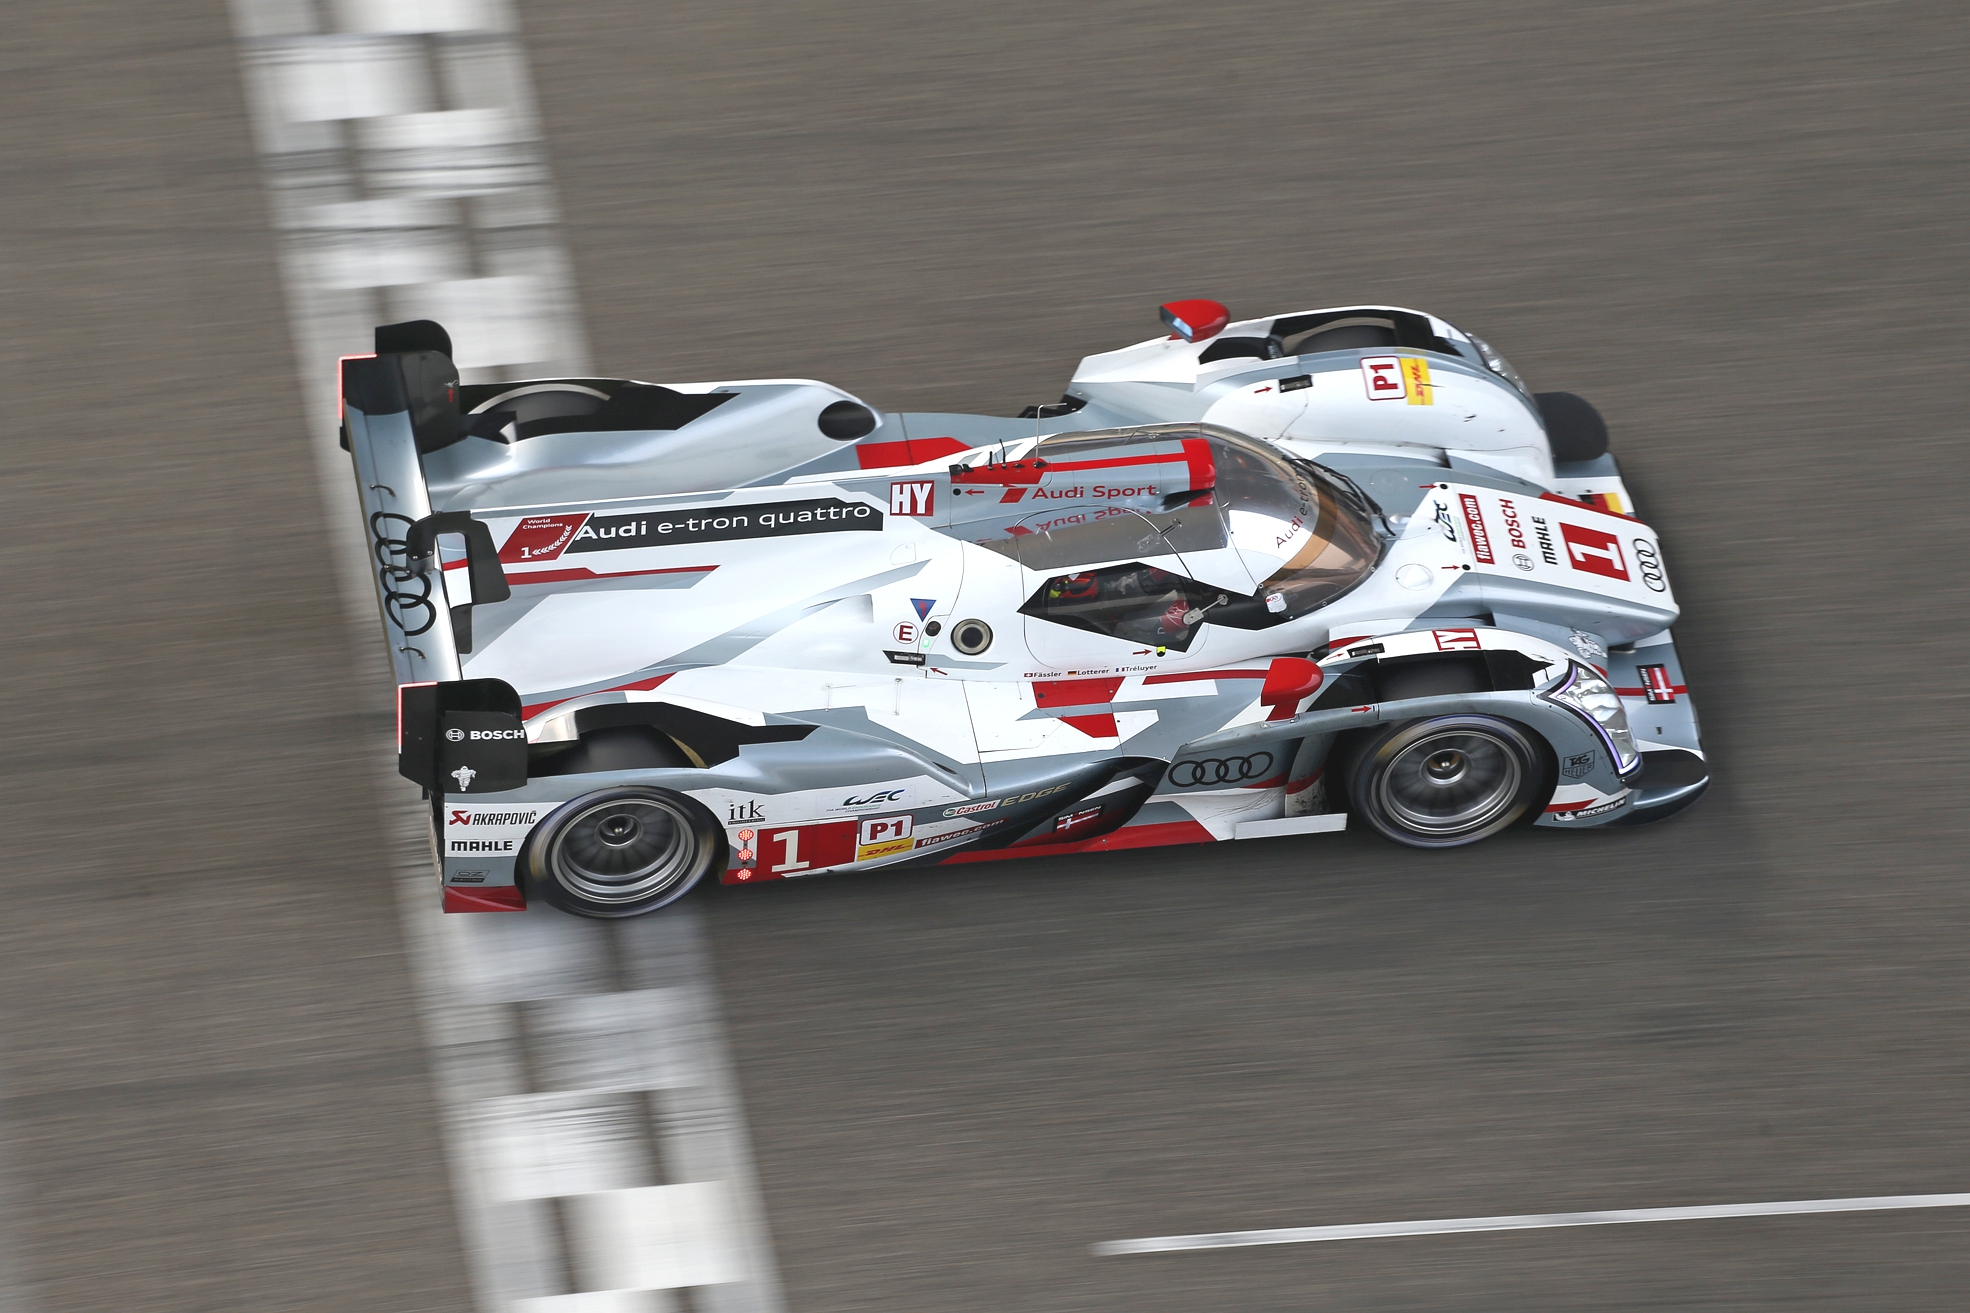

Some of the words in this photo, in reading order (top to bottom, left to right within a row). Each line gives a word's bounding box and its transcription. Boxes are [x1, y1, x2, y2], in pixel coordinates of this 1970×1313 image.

[1369, 364, 1398, 390] P1
[891, 483, 933, 514] HY
[1032, 486, 1084, 499] Audi
[1092, 485, 1156, 500] Sport
[523, 522, 563, 530] Champions
[575, 521, 647, 541] Audi
[657, 515, 748, 535] e-tron
[759, 506, 871, 528] quattro
[1276, 516, 1304, 549] Audi
[1463, 498, 1491, 560] fiawec.com
[1499, 499, 1527, 549] BOSCH
[1531, 516, 1558, 565] MAHLE
[521, 547, 532, 558] 1
[1567, 542, 1625, 571] 1
[899, 625, 913, 641] E
[1077, 668, 1109, 676] Lotterer
[1126, 664, 1157, 673] Tréluyer
[470, 729, 525, 740] BOSCH
[1569, 754, 1590, 766] TAG
[843, 789, 905, 806] WEC
[1000, 782, 1071, 807] EDGE
[728, 799, 765, 820] itk
[956, 801, 996, 815] Castrol
[1577, 798, 1625, 816] MICHELIN
[869, 820, 903, 840] P1
[921, 819, 1004, 847] fiawec.com
[451, 841, 513, 851] MAHLE
[771, 830, 810, 873] 1
[866, 845, 905, 856] DHL
